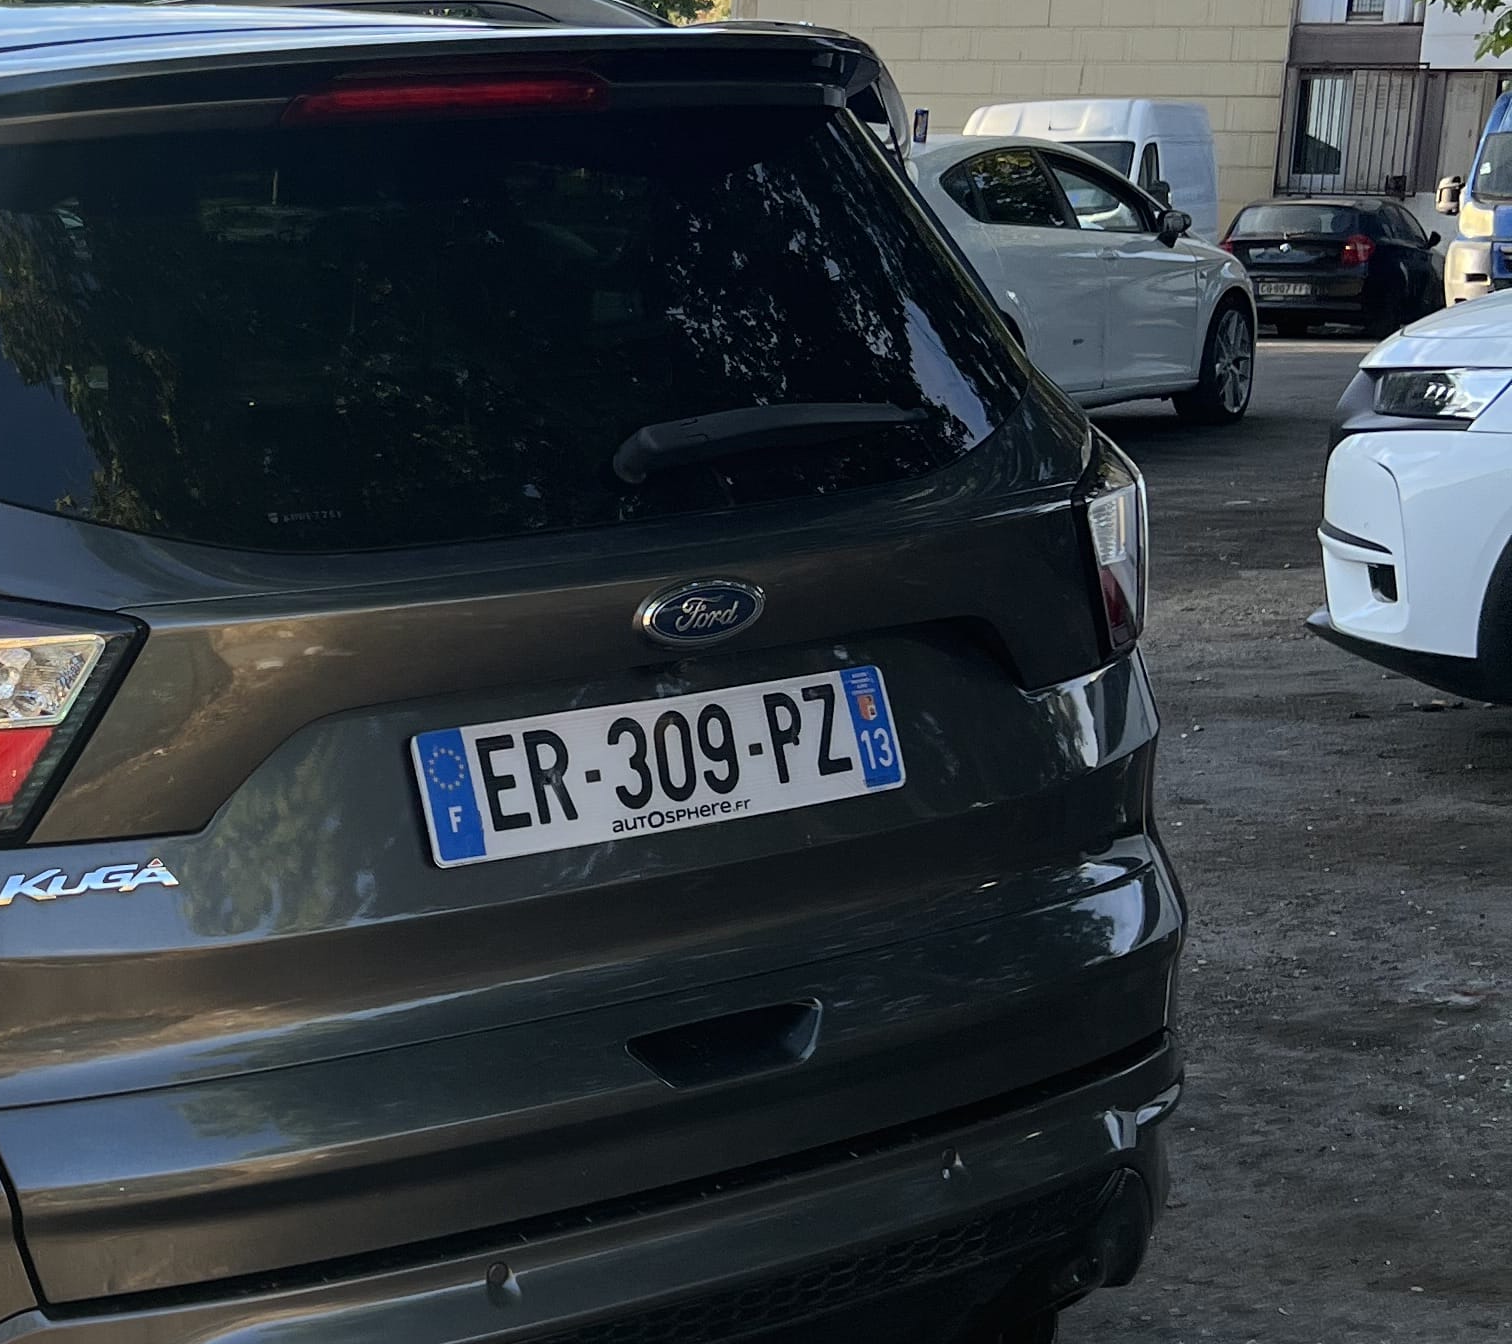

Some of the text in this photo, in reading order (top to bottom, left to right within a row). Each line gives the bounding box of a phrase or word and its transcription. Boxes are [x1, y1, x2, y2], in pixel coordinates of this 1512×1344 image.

[669, 595, 740, 632] Ford
[475, 683, 854, 832] ER-309-PZ
[860, 727, 894, 770] 13
[448, 805, 463, 833] F
